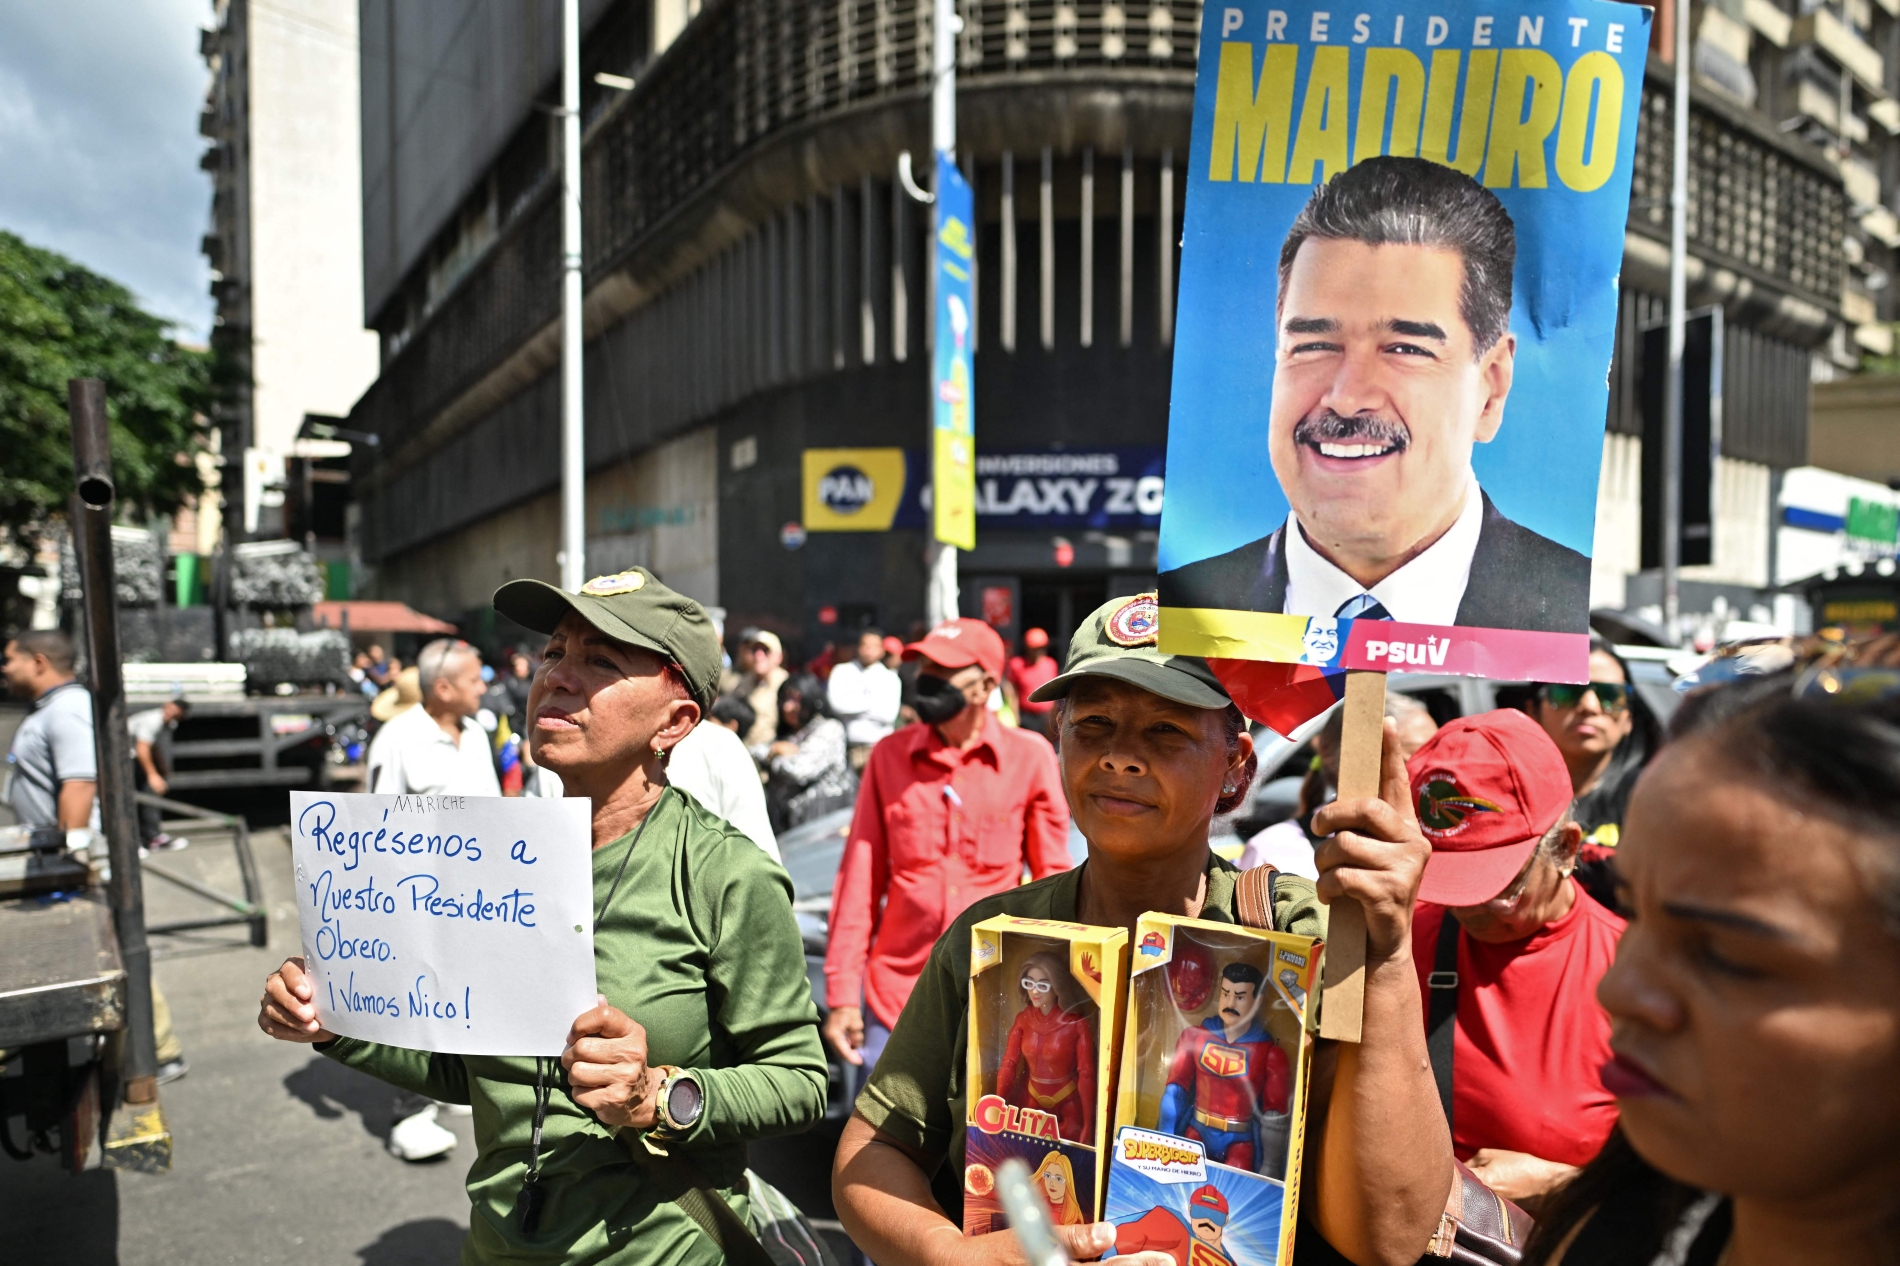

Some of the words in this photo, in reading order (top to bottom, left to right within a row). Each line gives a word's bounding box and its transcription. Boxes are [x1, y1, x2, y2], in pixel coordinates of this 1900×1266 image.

[1221, 8, 1625, 54] PRESIDENTE
[1208, 41, 1625, 192] MADURO
[977, 454, 1120, 475] INVERSIONES
[817, 473, 874, 503] PAN
[392, 795, 466, 814] MARICHE
[299, 800, 482, 871] Regrésenos
[510, 839, 538, 865] a
[397, 874, 537, 928] Presidente
[315, 919, 397, 962] Obrero.
[408, 975, 471, 1029] Nico!
[1203, 1045, 1245, 1076] SB
[1124, 1138, 1201, 1167] SUPERBIGOTE
[1151, 1165, 1171, 1173] MANO
